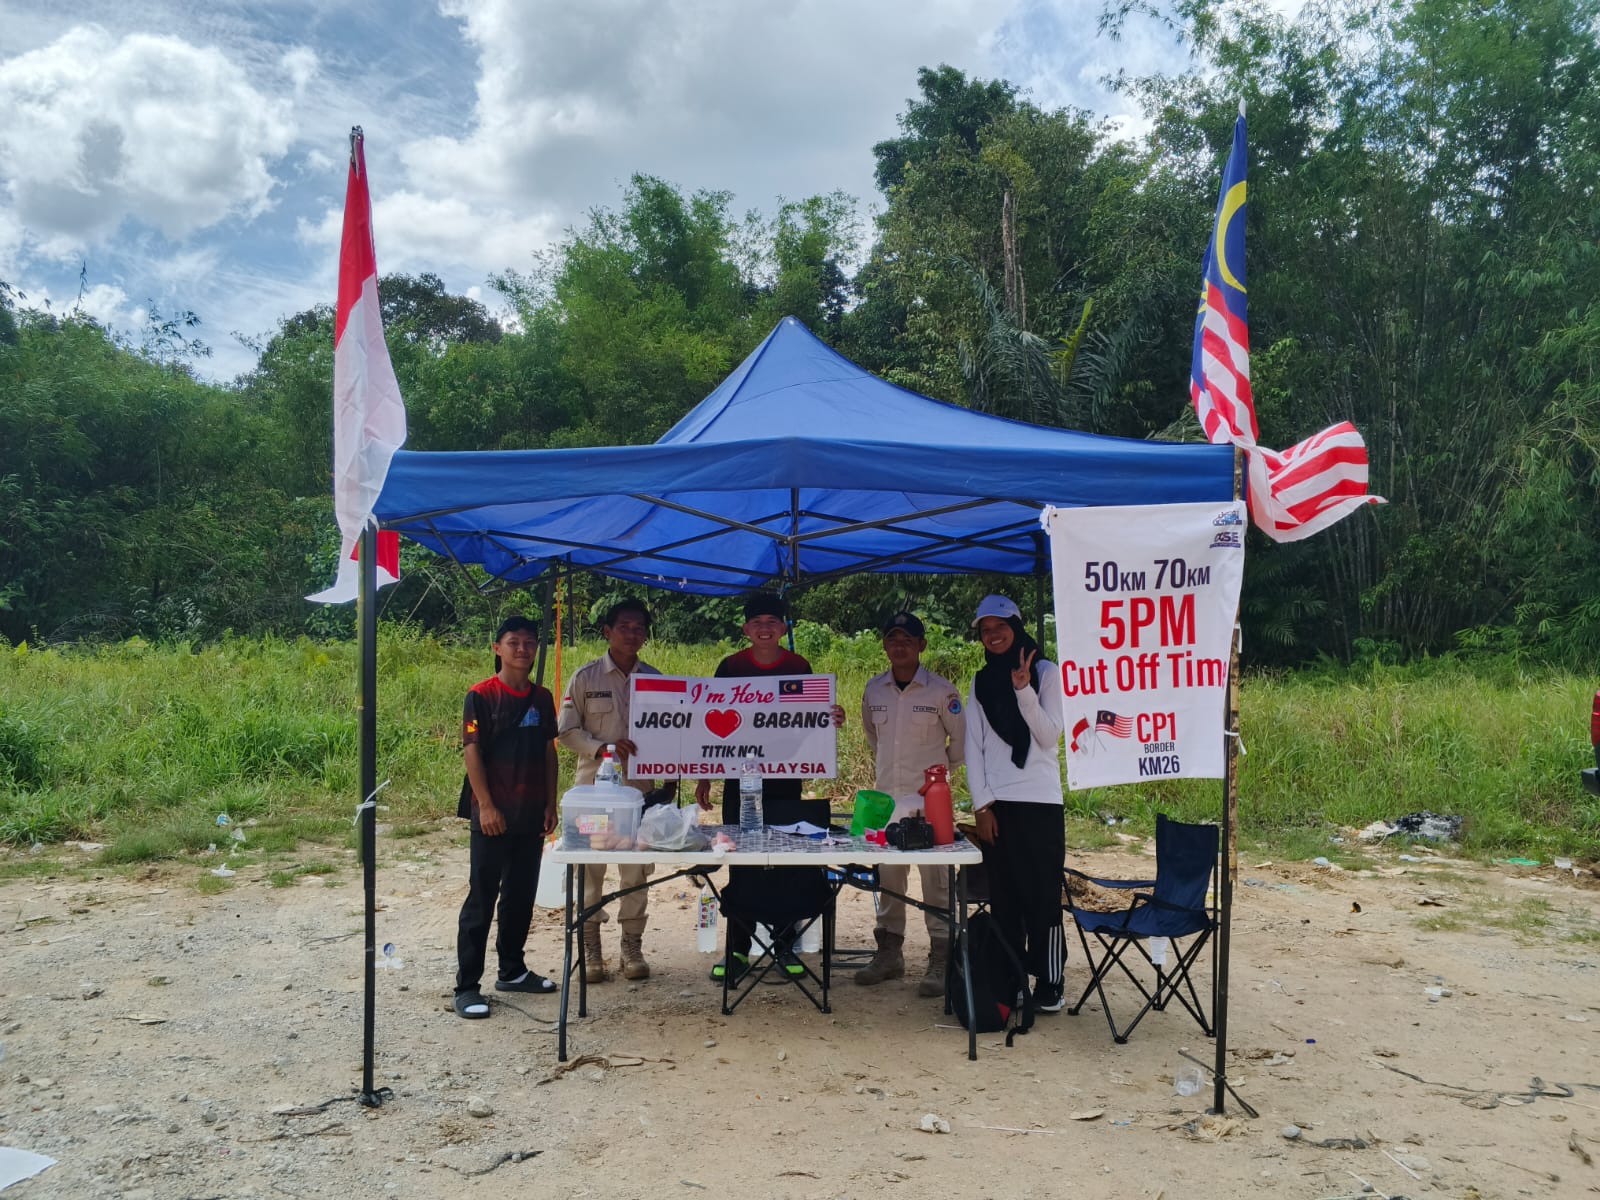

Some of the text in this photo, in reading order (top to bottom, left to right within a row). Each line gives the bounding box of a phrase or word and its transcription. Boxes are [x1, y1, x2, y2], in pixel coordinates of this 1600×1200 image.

[1085, 558, 1211, 592] 50KM 70KM
[1100, 593, 1196, 650] 5PM
[1062, 660, 1109, 697] Cut
[1116, 653, 1160, 692] Off
[691, 683, 774, 704] I'm Here
[635, 712, 830, 729] JAGOI BABANG
[1136, 712, 1177, 743] CP1
[702, 745, 736, 758] TITIK
[1144, 742, 1175, 754] BORDER
[637, 763, 726, 775] INDONESIA
[741, 763, 826, 774] ALAYSIA
[1138, 755, 1180, 776] KM26
